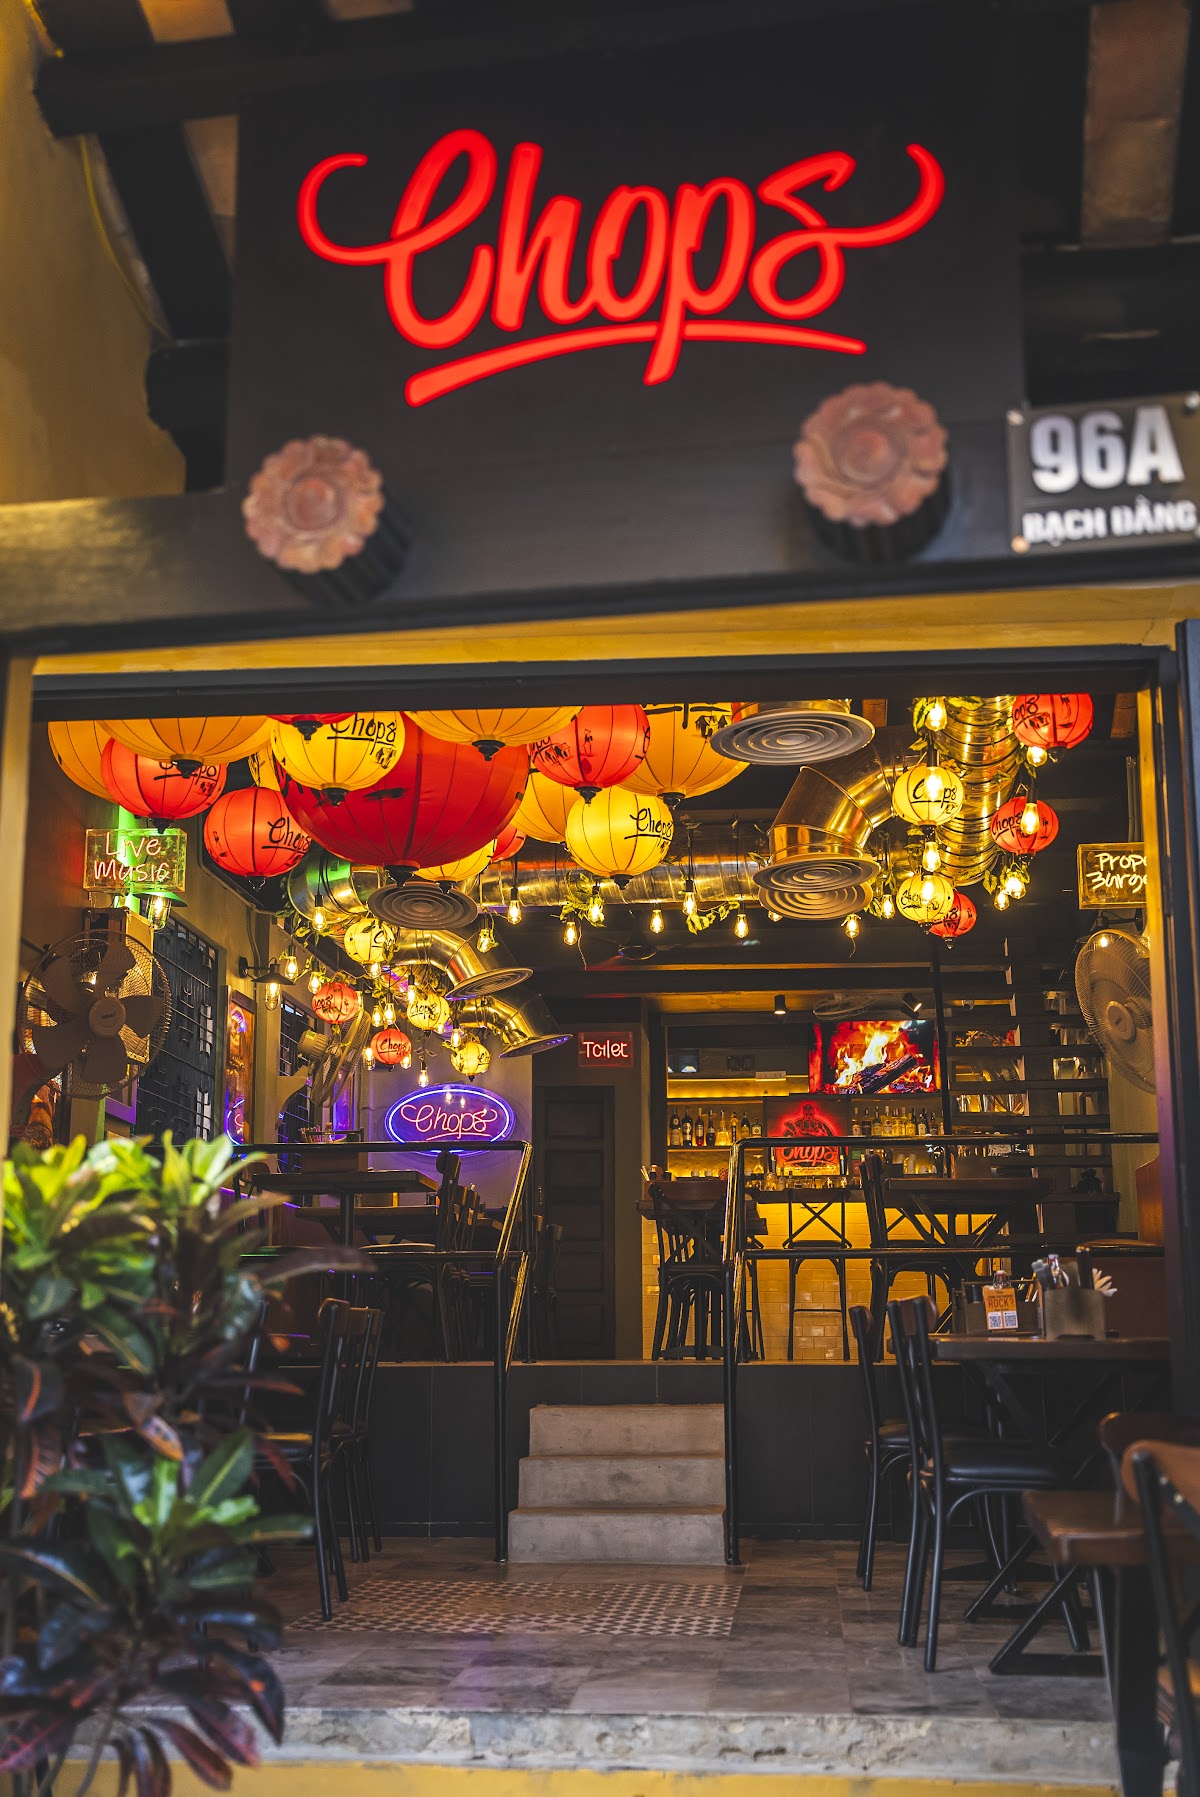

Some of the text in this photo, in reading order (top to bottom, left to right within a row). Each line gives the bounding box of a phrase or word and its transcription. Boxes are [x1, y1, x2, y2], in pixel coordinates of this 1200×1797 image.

[298, 129, 945, 388] Chops
[1031, 405, 1185, 493] 96A
[105, 832, 161, 857] Live
[94, 858, 170, 882] Music
[582, 1040, 628, 1059] Toilet
[400, 1104, 498, 1139] Chops
